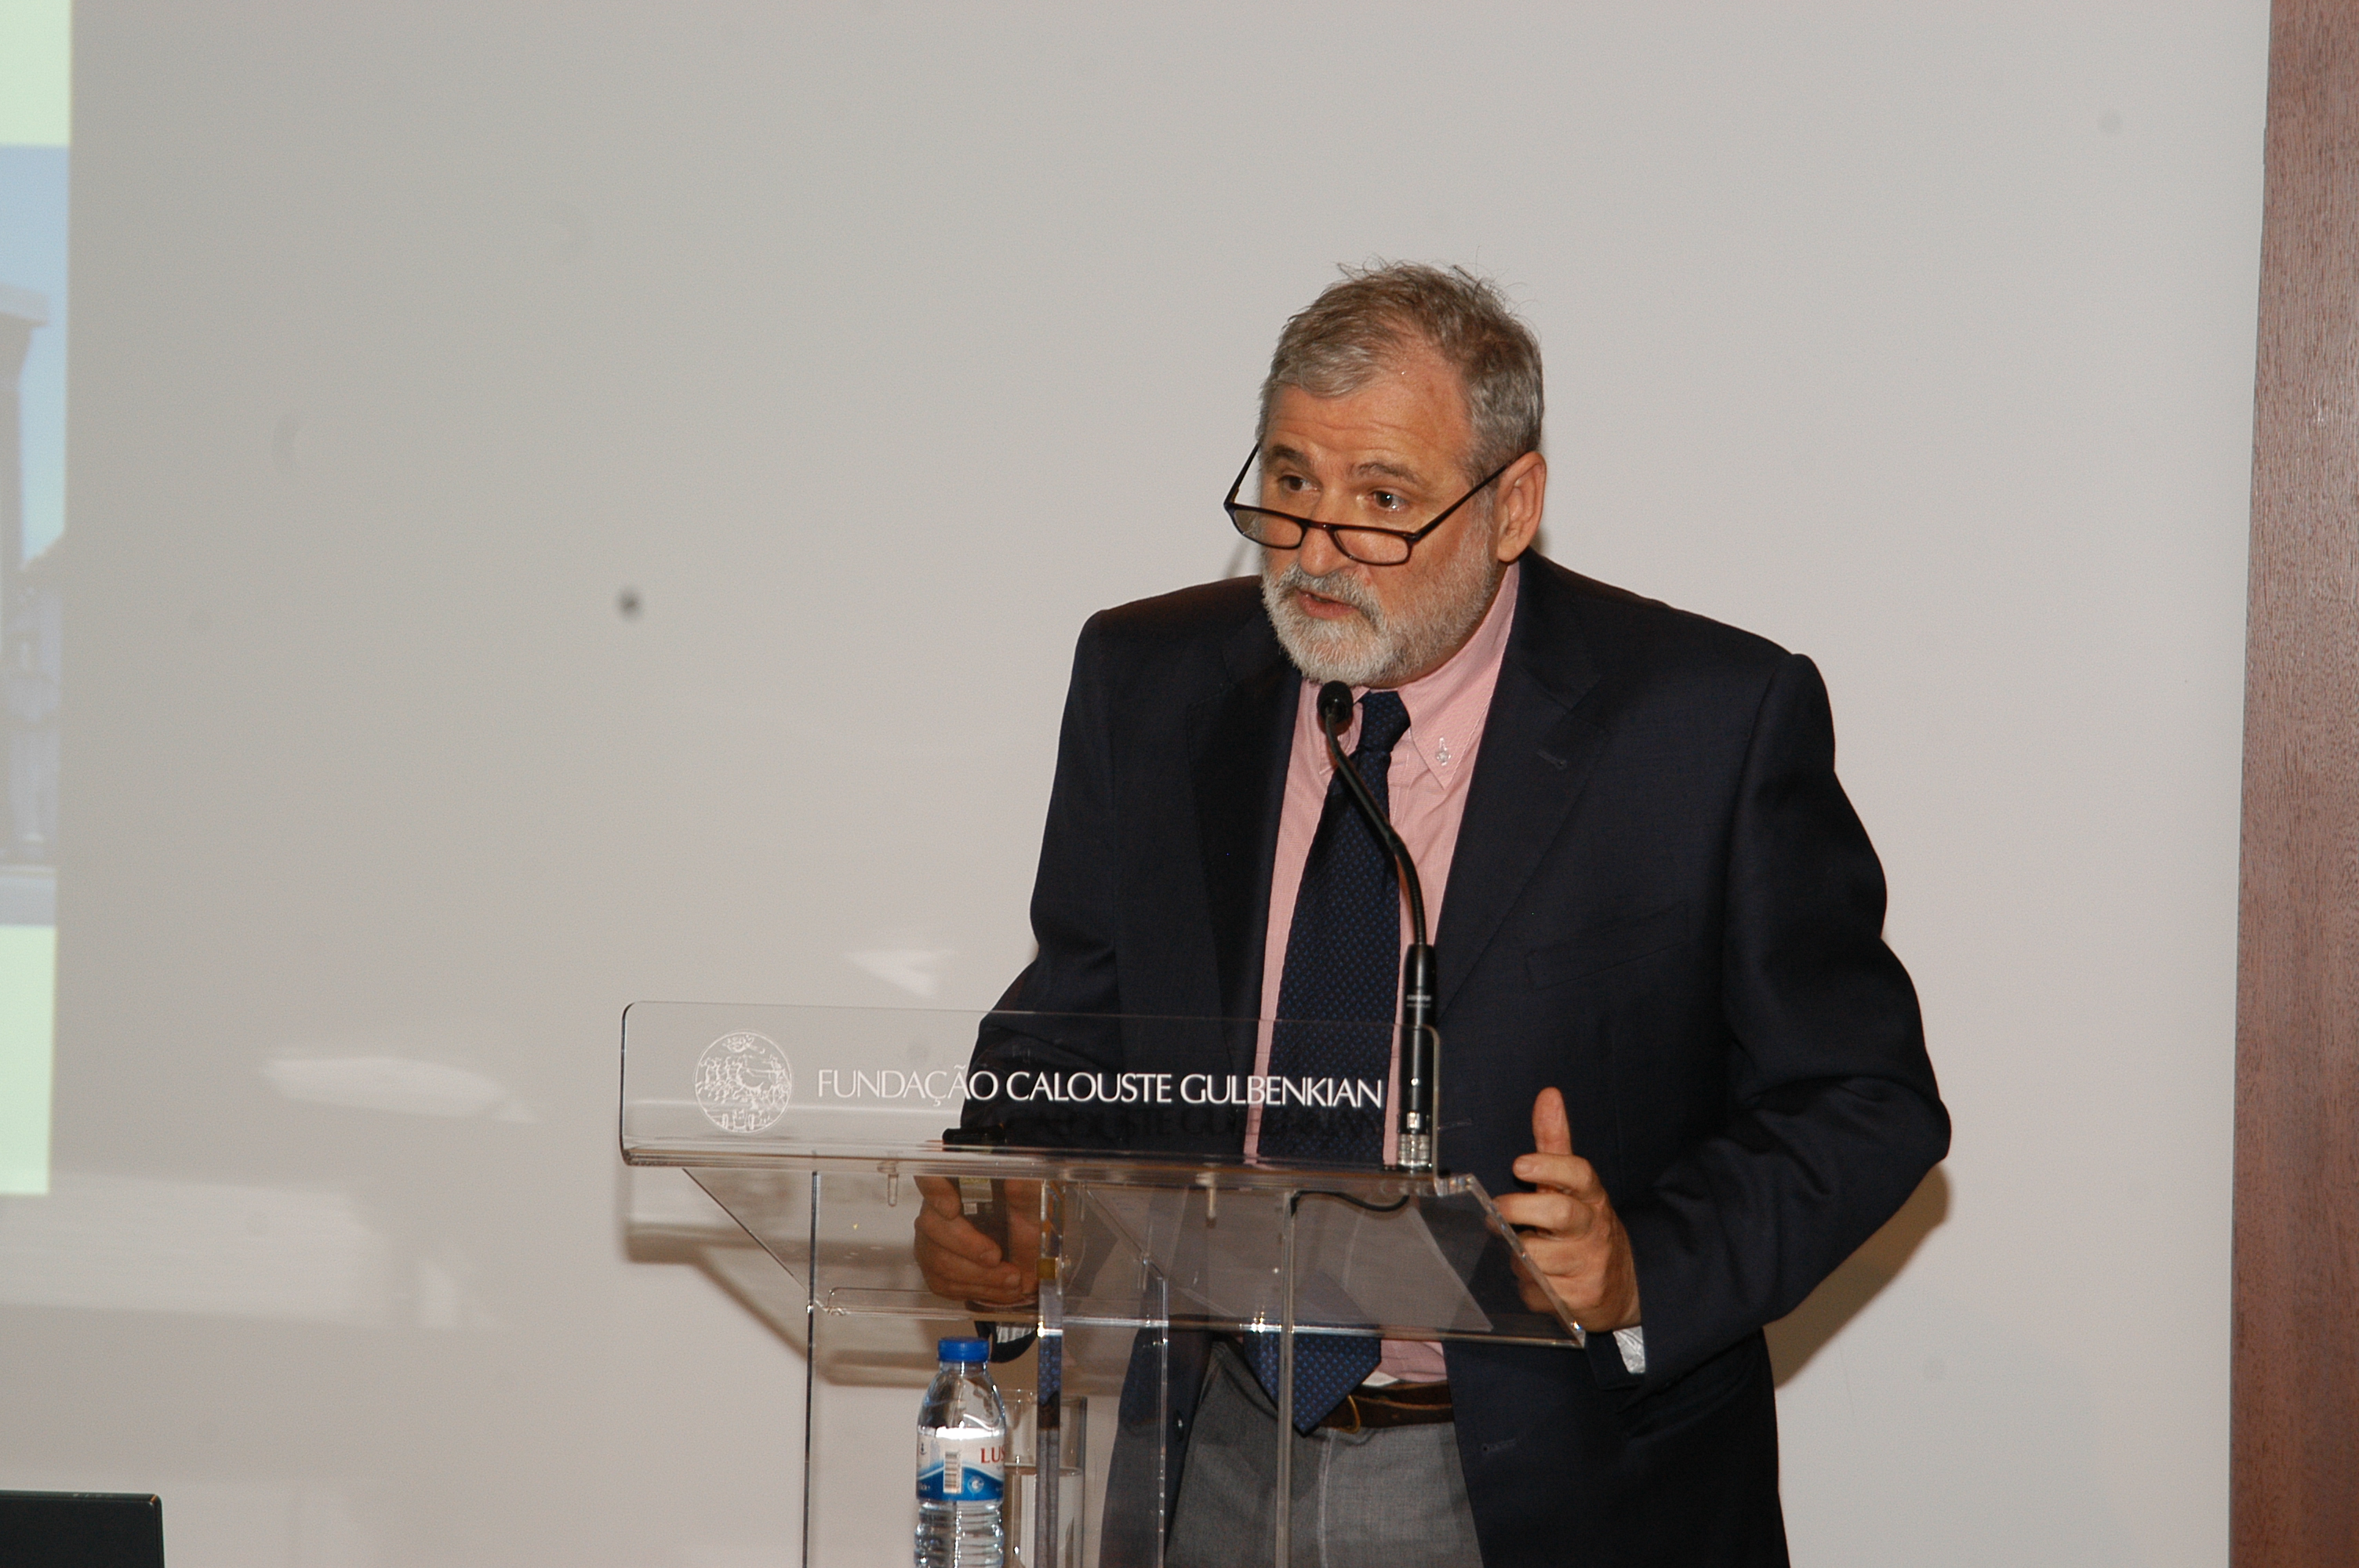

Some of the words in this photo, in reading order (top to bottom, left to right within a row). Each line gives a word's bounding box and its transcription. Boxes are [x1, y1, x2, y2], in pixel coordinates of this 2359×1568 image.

[818, 1065, 999, 1106] FUNDAÇÃO
[1006, 1071, 1172, 1103] CALOUSTE
[1180, 1073, 1382, 1109] GULBENKIAN
